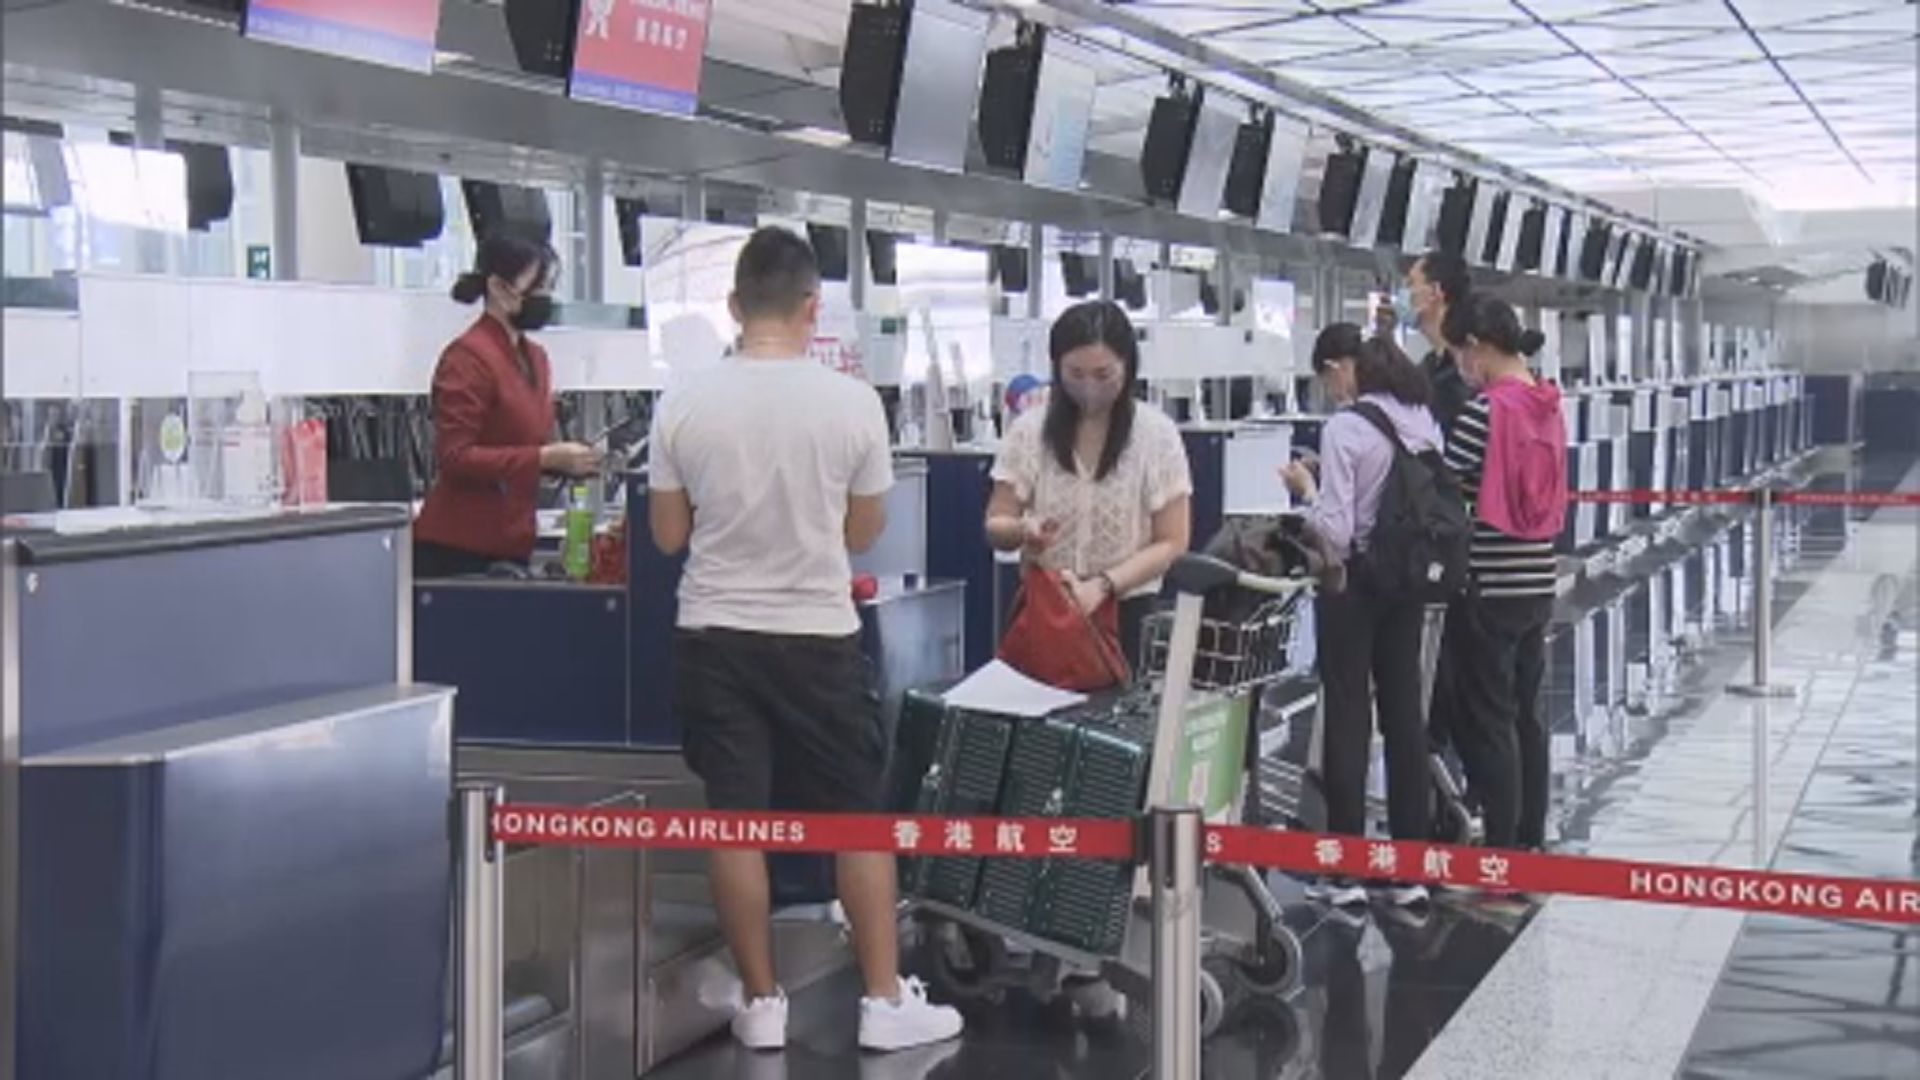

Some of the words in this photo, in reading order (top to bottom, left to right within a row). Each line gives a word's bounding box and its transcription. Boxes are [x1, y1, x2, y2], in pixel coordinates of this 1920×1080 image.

[664, 817, 805, 842] AIRLINES
[893, 819, 1078, 853] 香港航空
[1313, 838, 1510, 886] 香港航空
[1629, 870, 1844, 909] HONGKONG
